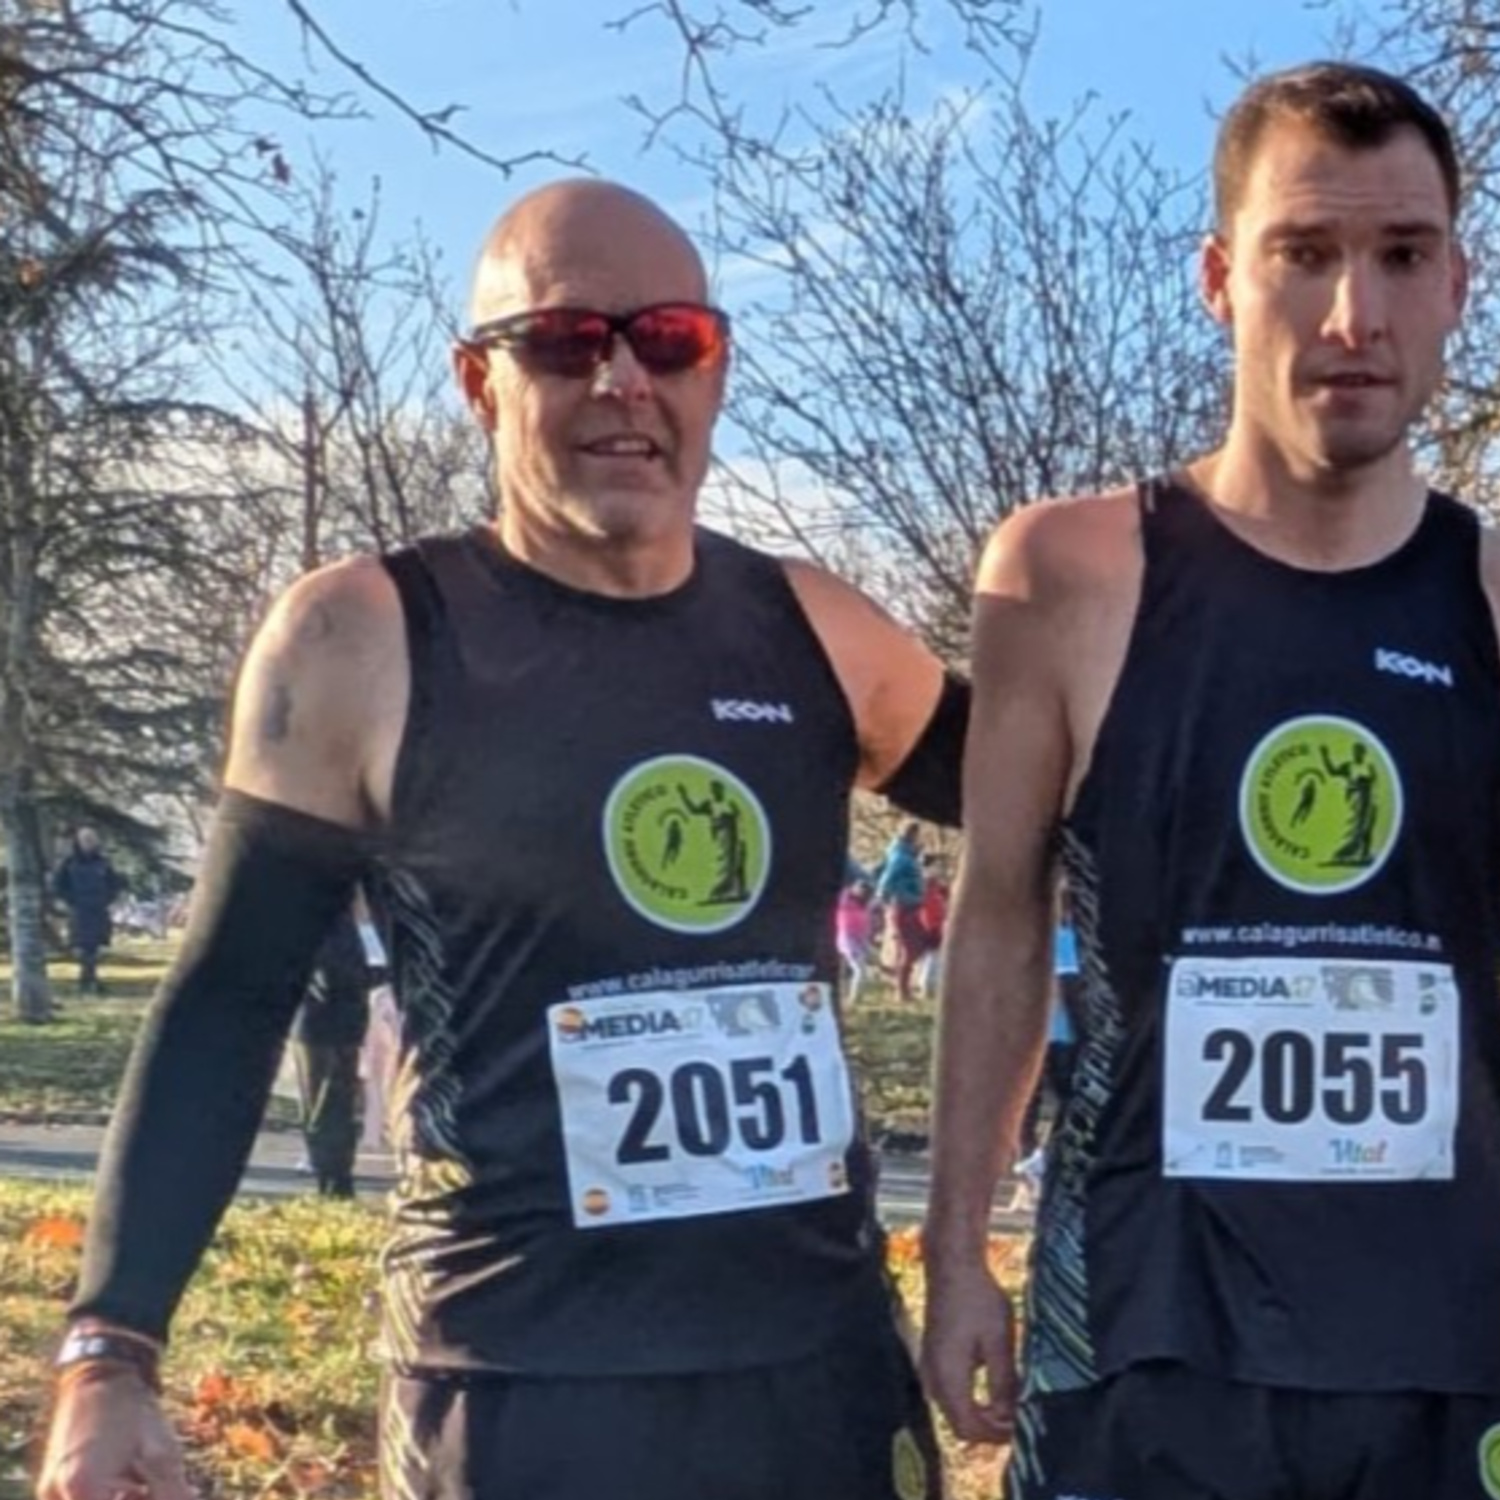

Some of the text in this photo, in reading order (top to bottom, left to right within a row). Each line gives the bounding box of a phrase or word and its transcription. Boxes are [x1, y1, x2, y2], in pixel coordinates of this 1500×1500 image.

[1197, 975, 1291, 1000] MEDIA
[579, 1010, 681, 1041] MEDIA
[1201, 1028, 1428, 1126] 2055
[607, 1054, 821, 1165] 2051
